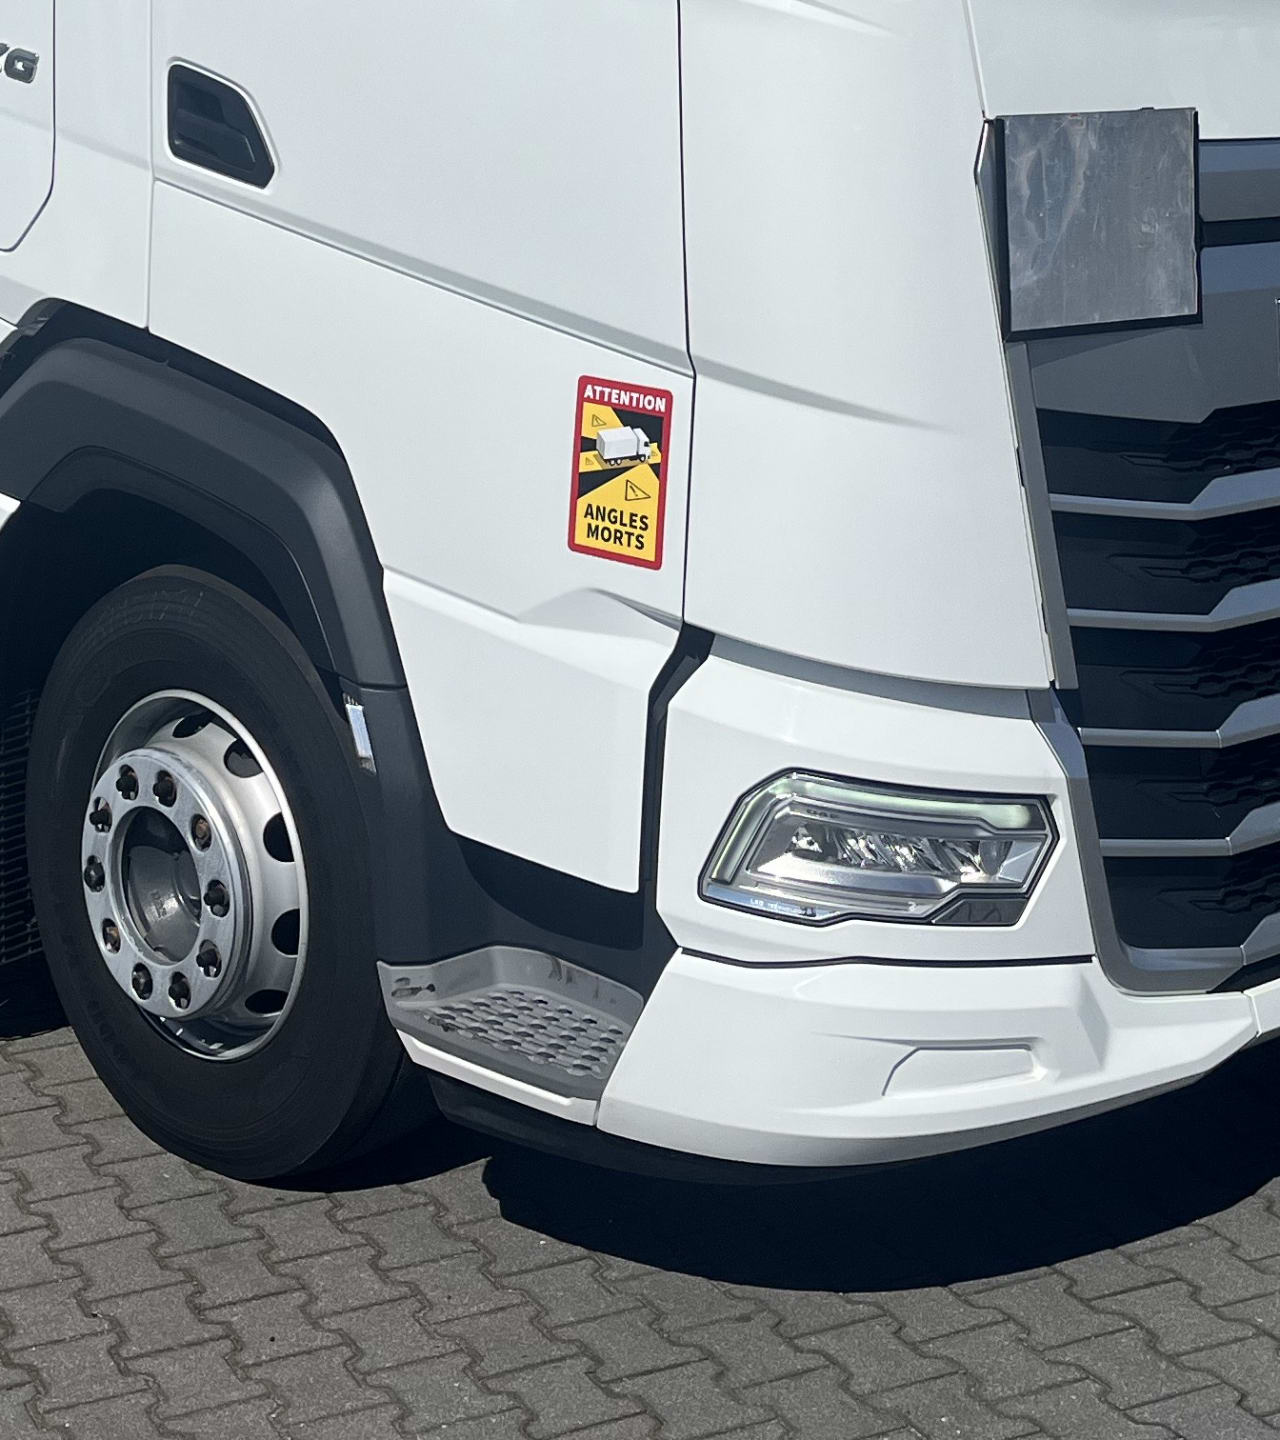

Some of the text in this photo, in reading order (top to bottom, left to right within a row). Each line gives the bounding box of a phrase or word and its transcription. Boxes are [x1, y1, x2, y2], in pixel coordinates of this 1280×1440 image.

[584, 384, 666, 413] ATTENTION
[584, 503, 649, 531] ANGLES
[586, 523, 645, 551] MORTS
